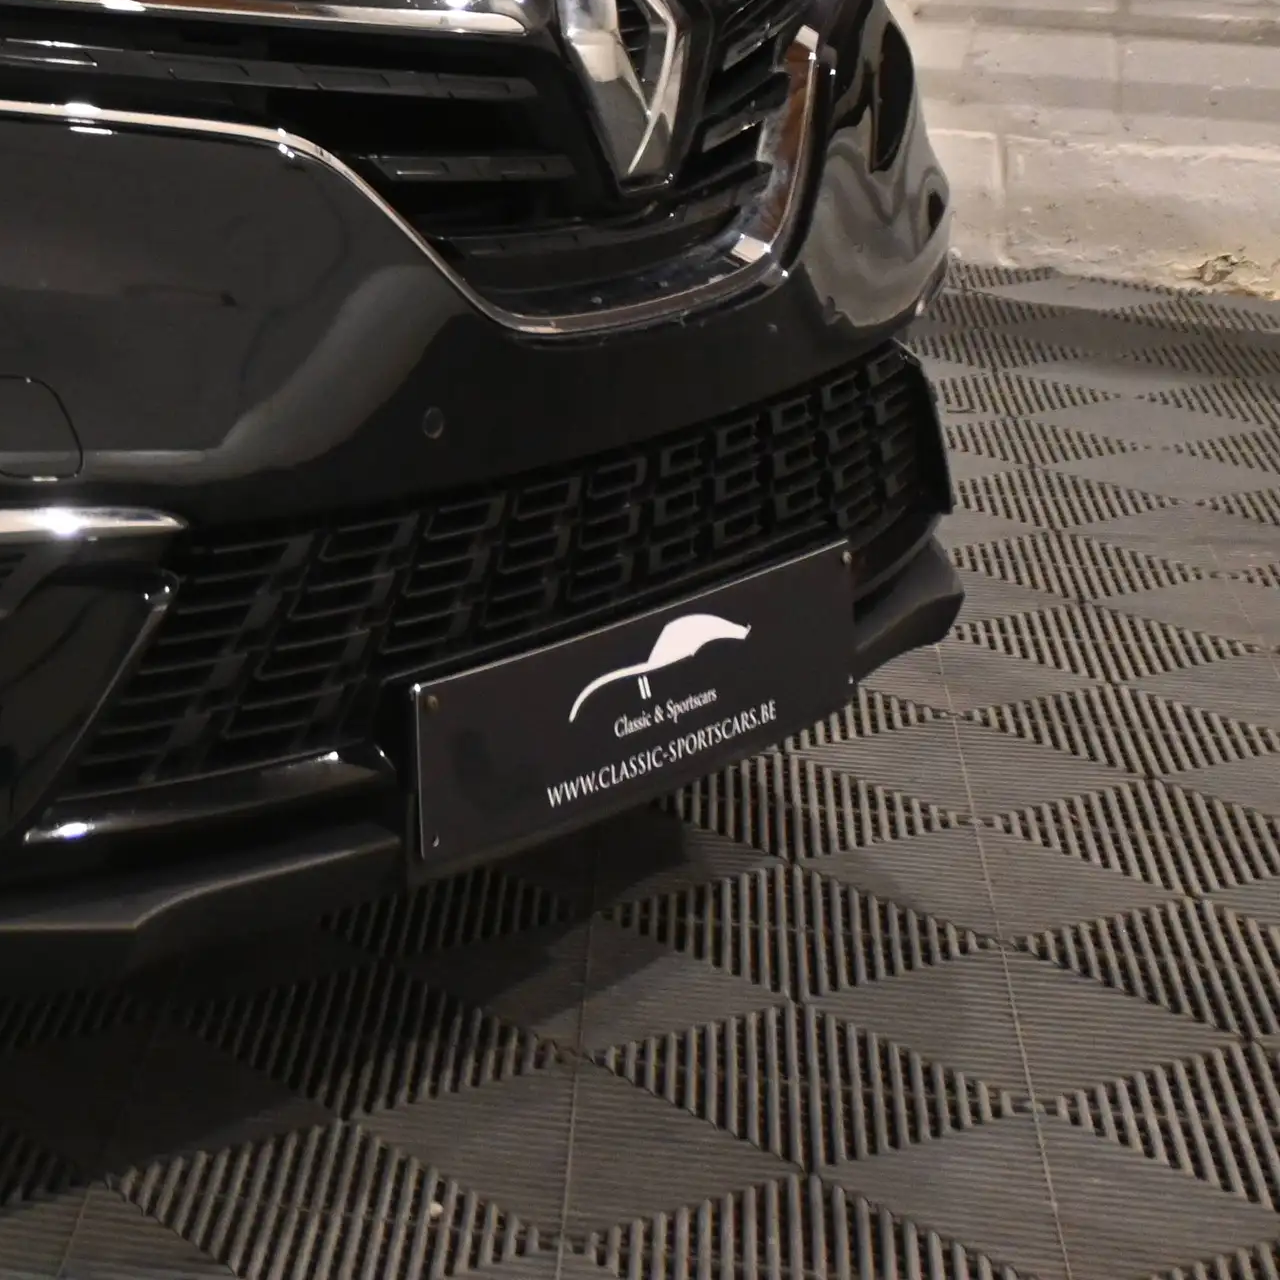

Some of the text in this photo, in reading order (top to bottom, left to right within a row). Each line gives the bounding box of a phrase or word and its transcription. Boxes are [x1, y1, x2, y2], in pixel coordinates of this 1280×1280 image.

[614, 688, 718, 738] Classic & Sportscars
[547, 699, 777, 808] WWW.CLASSIC-SPORTSCARS.BE
